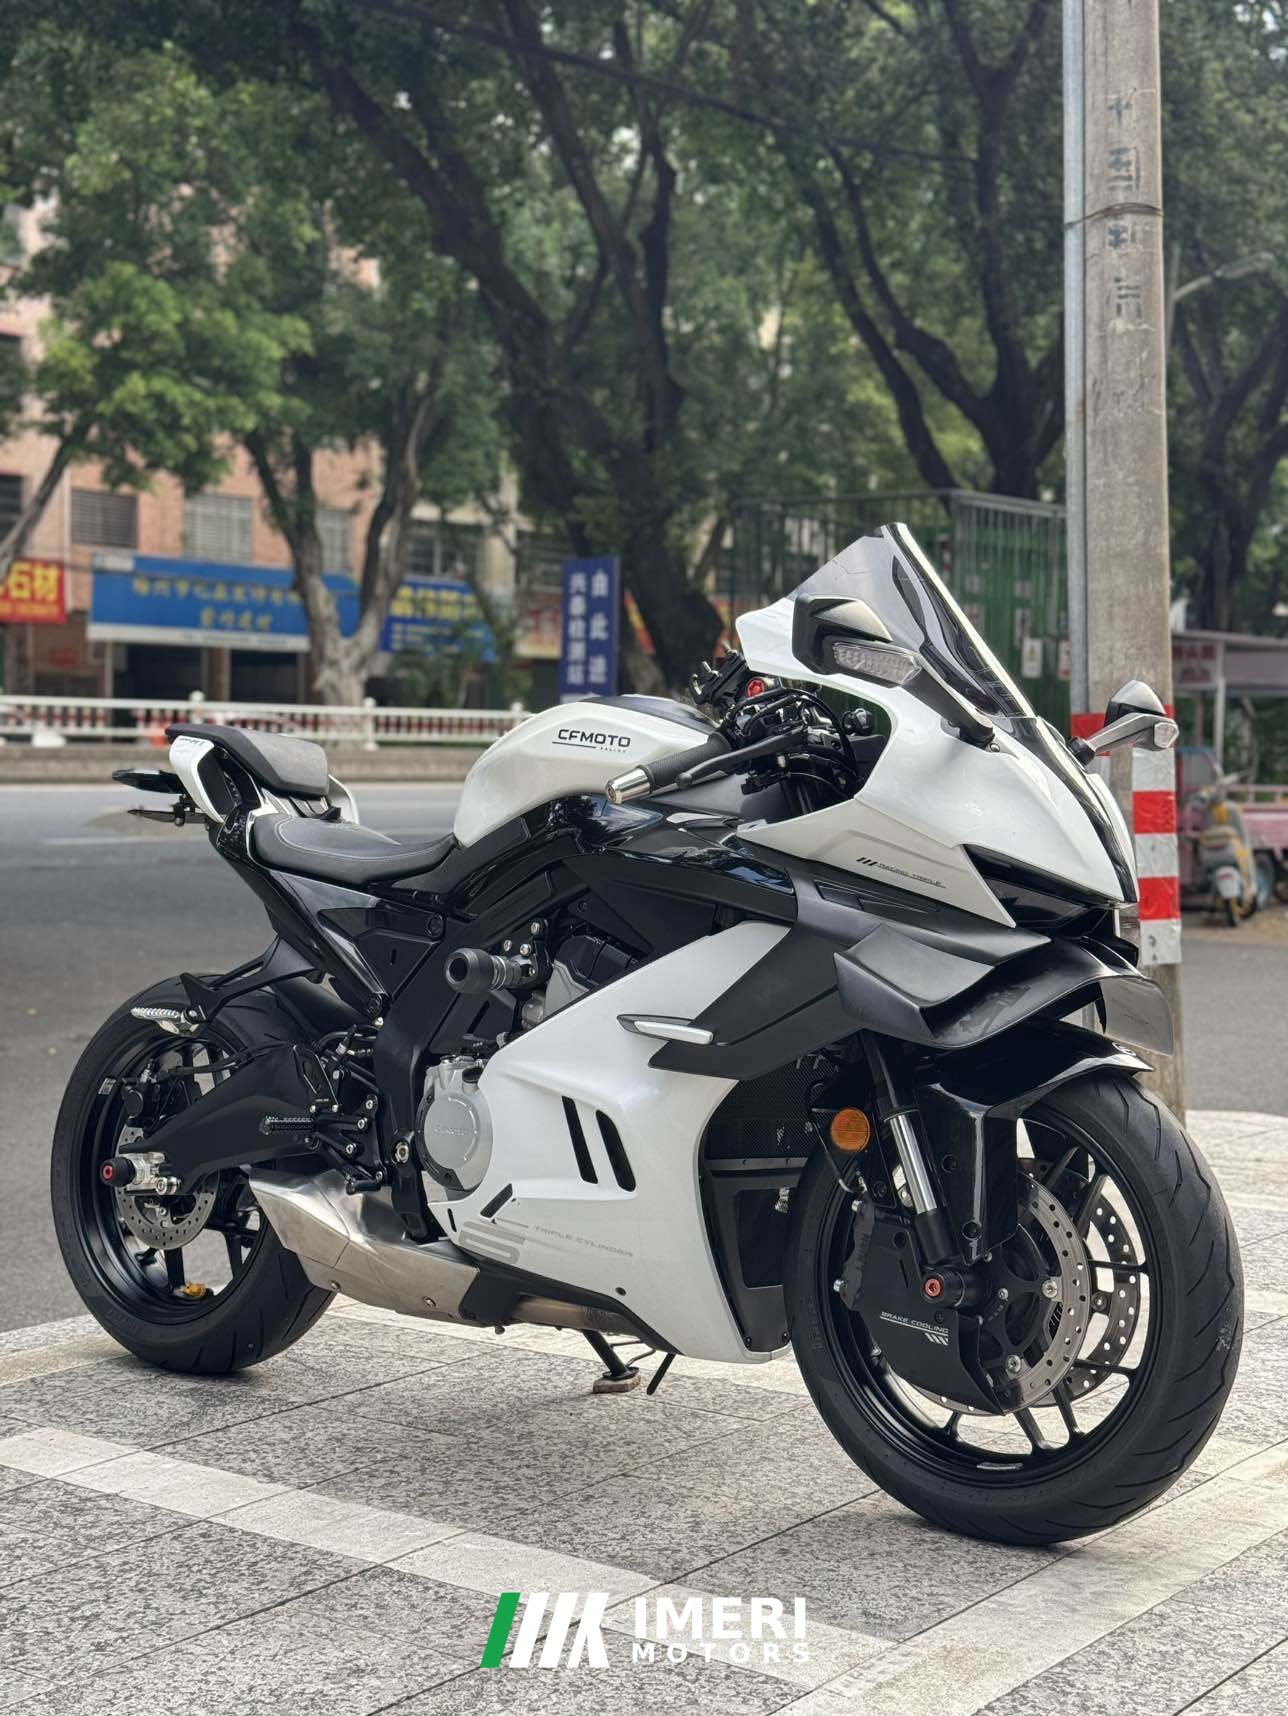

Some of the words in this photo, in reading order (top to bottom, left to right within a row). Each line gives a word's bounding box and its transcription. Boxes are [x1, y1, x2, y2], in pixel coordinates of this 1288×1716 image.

[0, 561, 58, 602] 石材
[558, 728, 631, 747] CFMOTO
[534, 1226, 573, 1240] TRIPLE
[881, 1311, 908, 1323] BRAKE
[910, 1319, 949, 1334] COOLING
